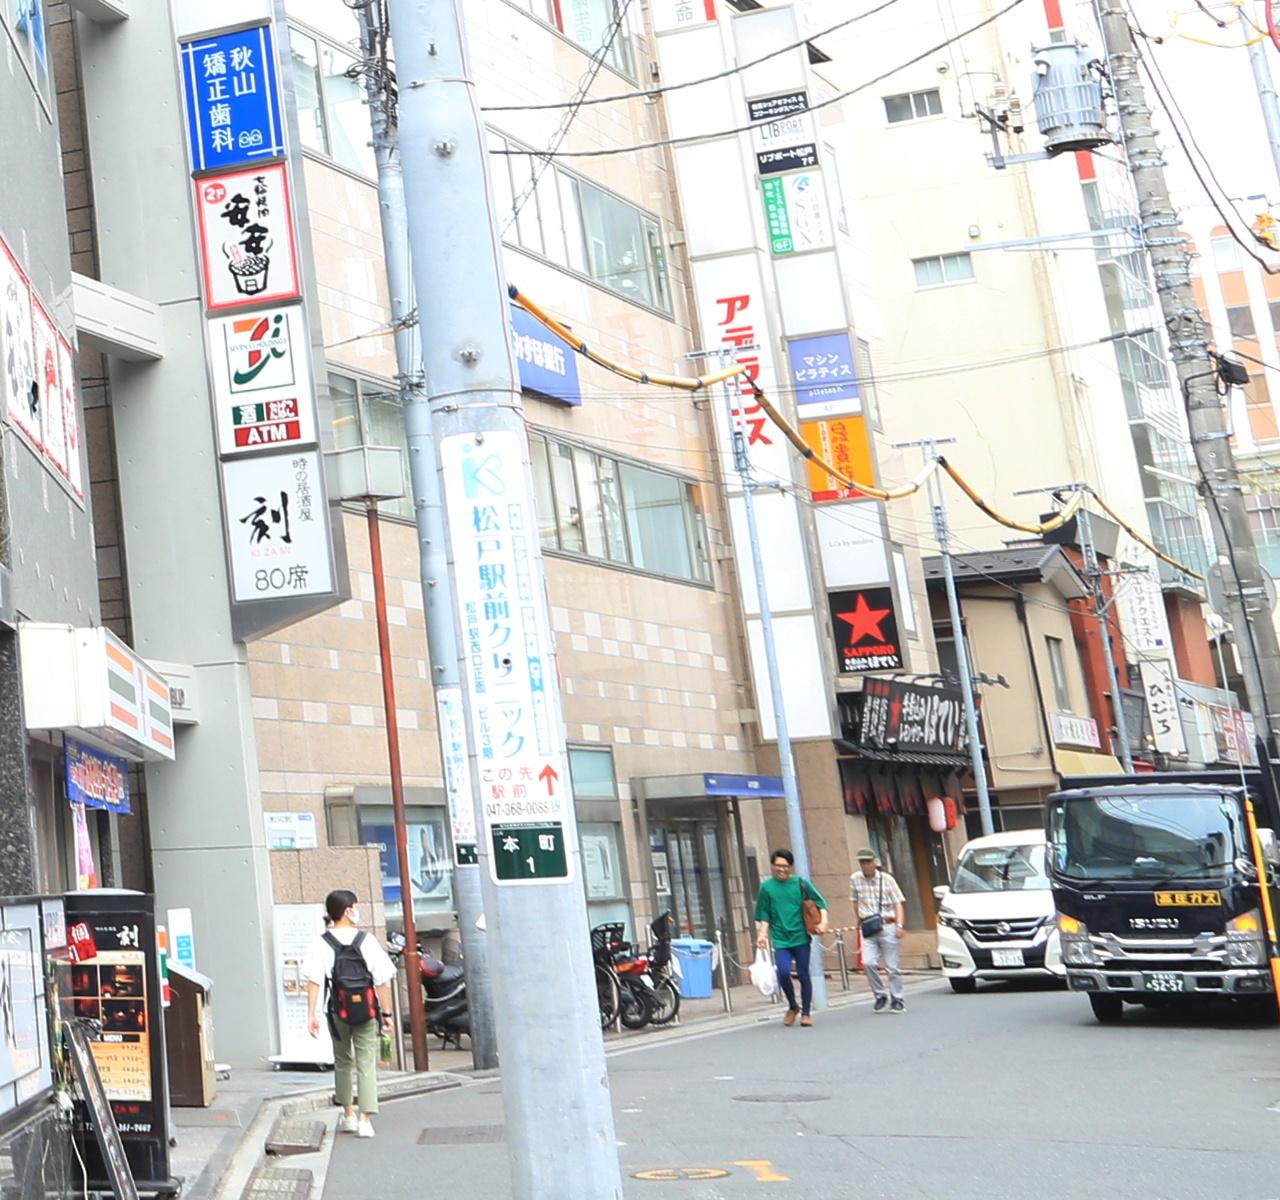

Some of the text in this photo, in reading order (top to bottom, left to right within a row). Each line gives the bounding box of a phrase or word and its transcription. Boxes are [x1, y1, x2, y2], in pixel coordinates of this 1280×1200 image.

[229, 46, 257, 97] 秋山
[202, 53, 235, 154] 矯正歯科
[800, 156, 816, 166] 7F
[204, 184, 226, 202] 2F
[803, 353, 839, 367] マシン
[238, 404, 258, 423] 酒
[268, 399, 299, 421] たばこ
[246, 424, 288, 444] ATM
[291, 458, 314, 522] 時の居酒屋
[239, 490, 294, 546] 刻
[254, 564, 310, 592] 80席
[471, 504, 525, 759] 松戸駅前クリニック
[843, 644, 896, 658] SAPPORO
[482, 767, 534, 783] この先
[491, 784, 528, 800] 駅前
[502, 834, 556, 852] 本町
[1128, 918, 1180, 929] ISUZU
[1151, 979, 1185, 992] 52-57
